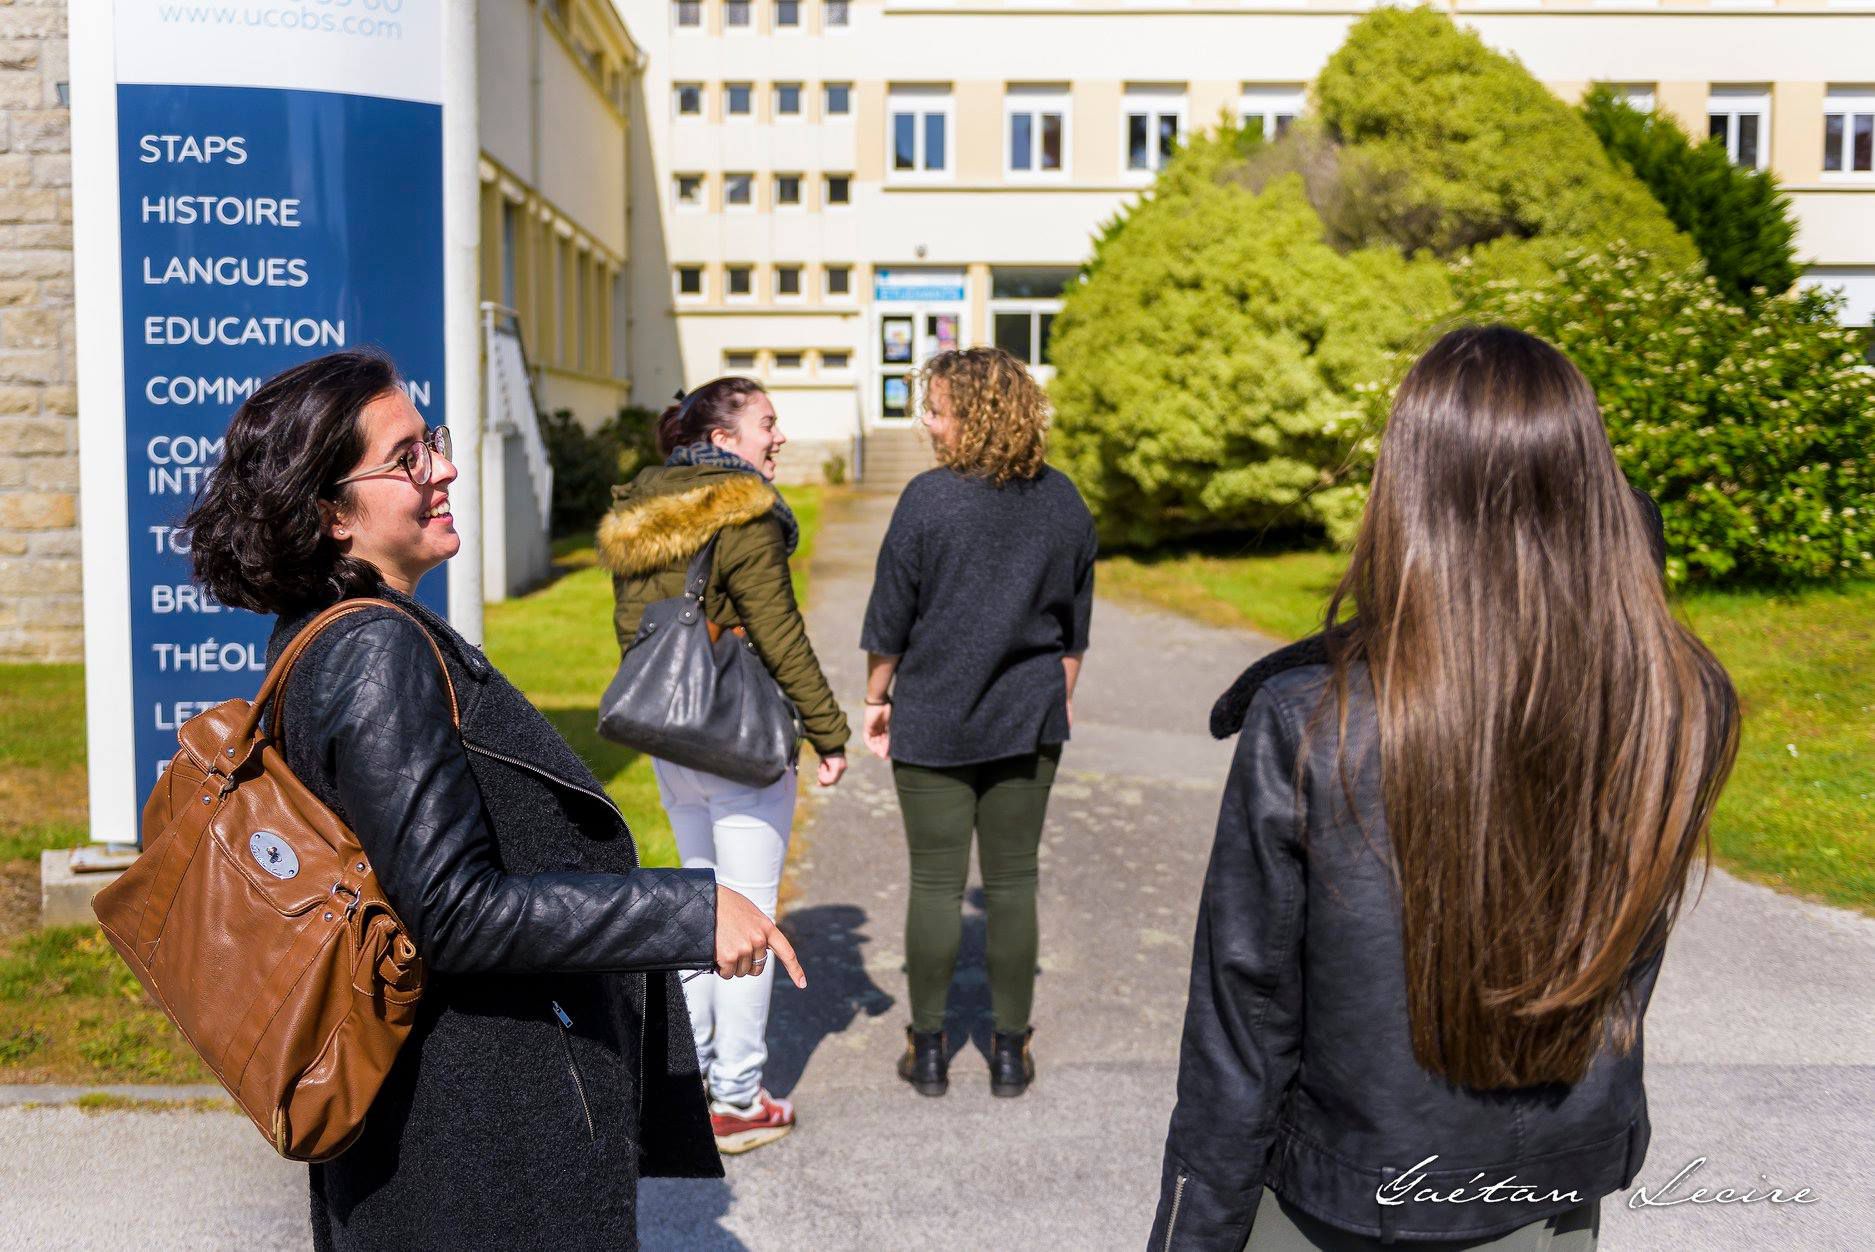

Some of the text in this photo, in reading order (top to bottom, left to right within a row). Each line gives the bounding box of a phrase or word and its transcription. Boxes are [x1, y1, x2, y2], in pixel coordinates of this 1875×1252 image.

[159, 5, 403, 40] www.ucobs.com
[139, 134, 248, 165] STAPS
[142, 196, 302, 227] HISTOIRE
[143, 256, 309, 288] LANGUES
[144, 316, 346, 347] EDUCATION
[152, 637, 266, 672] THÉOL
